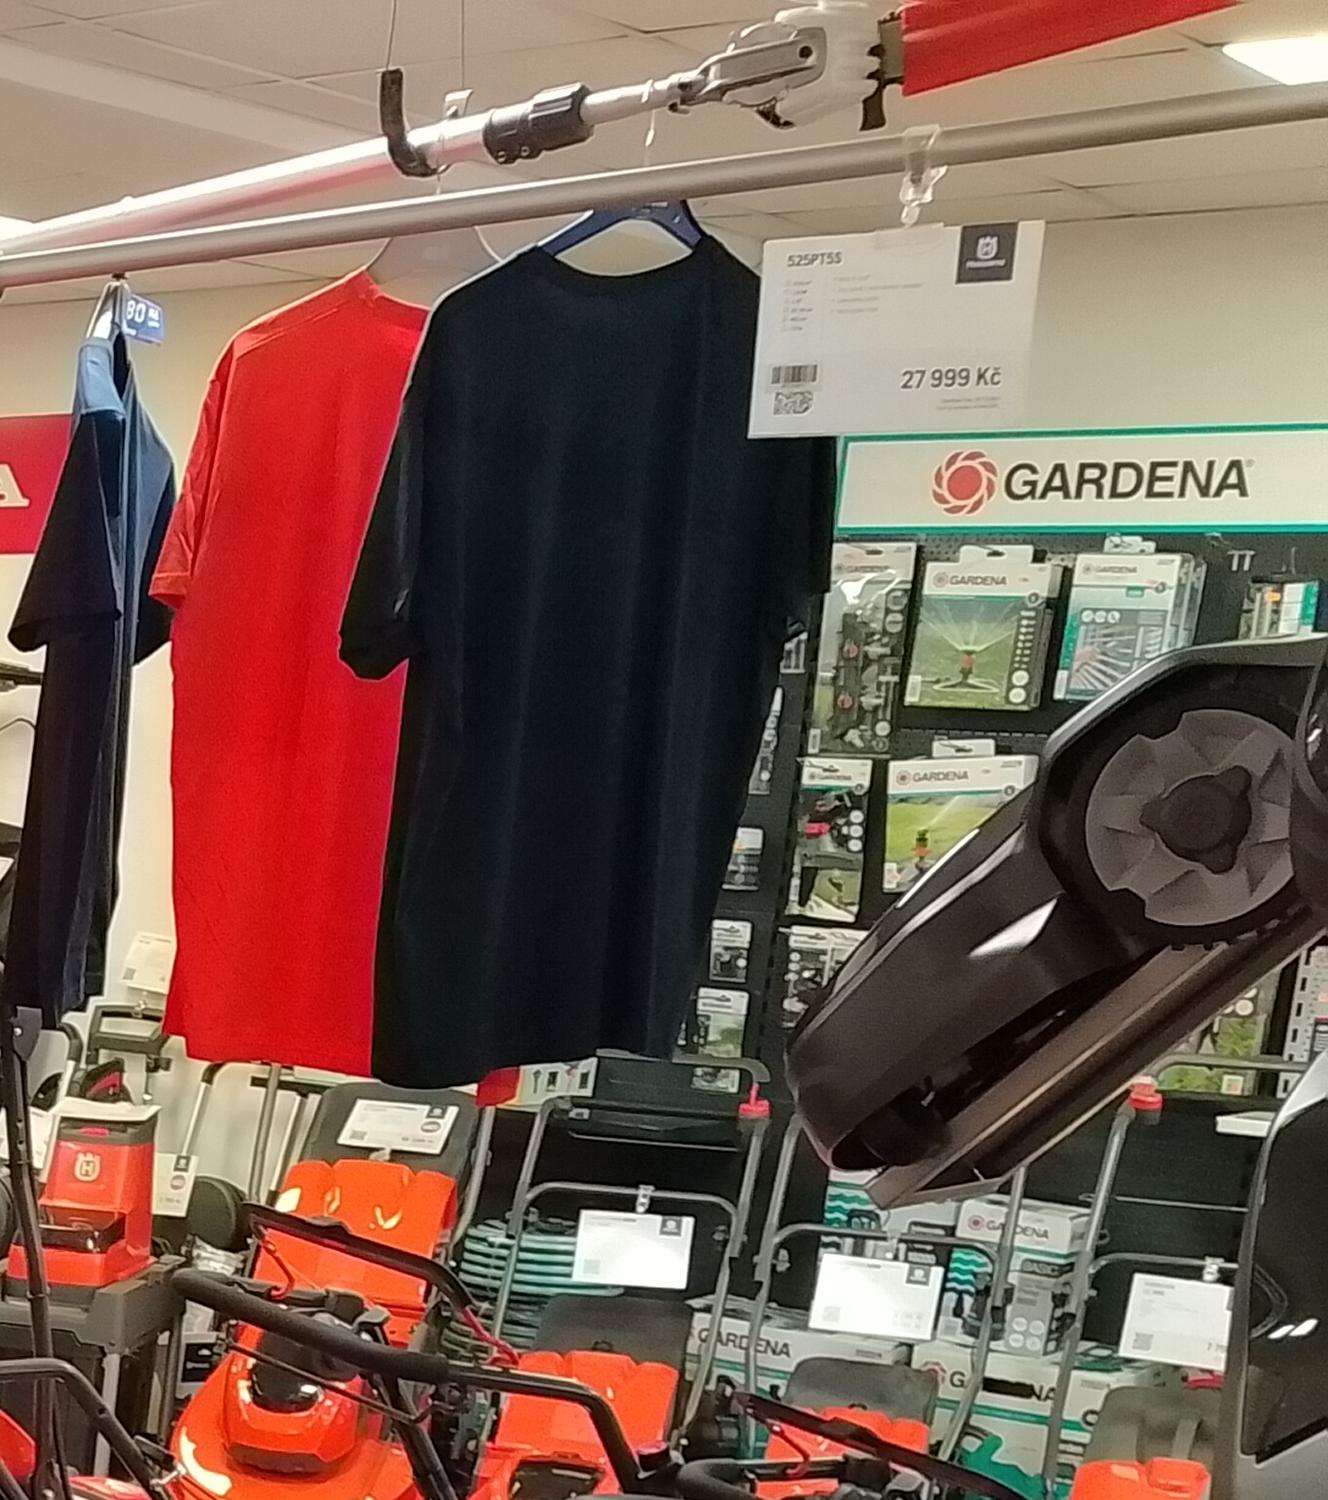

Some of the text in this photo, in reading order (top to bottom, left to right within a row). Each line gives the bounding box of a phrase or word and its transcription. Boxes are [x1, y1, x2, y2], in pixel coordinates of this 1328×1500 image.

[786, 251, 842, 267] 525PT5S
[900, 366, 1002, 389] 27 999 Kč
[1003, 458, 1250, 502] GARDENA
[949, 574, 1008, 587] GARDENA
[911, 769, 970, 783] GARDENA
